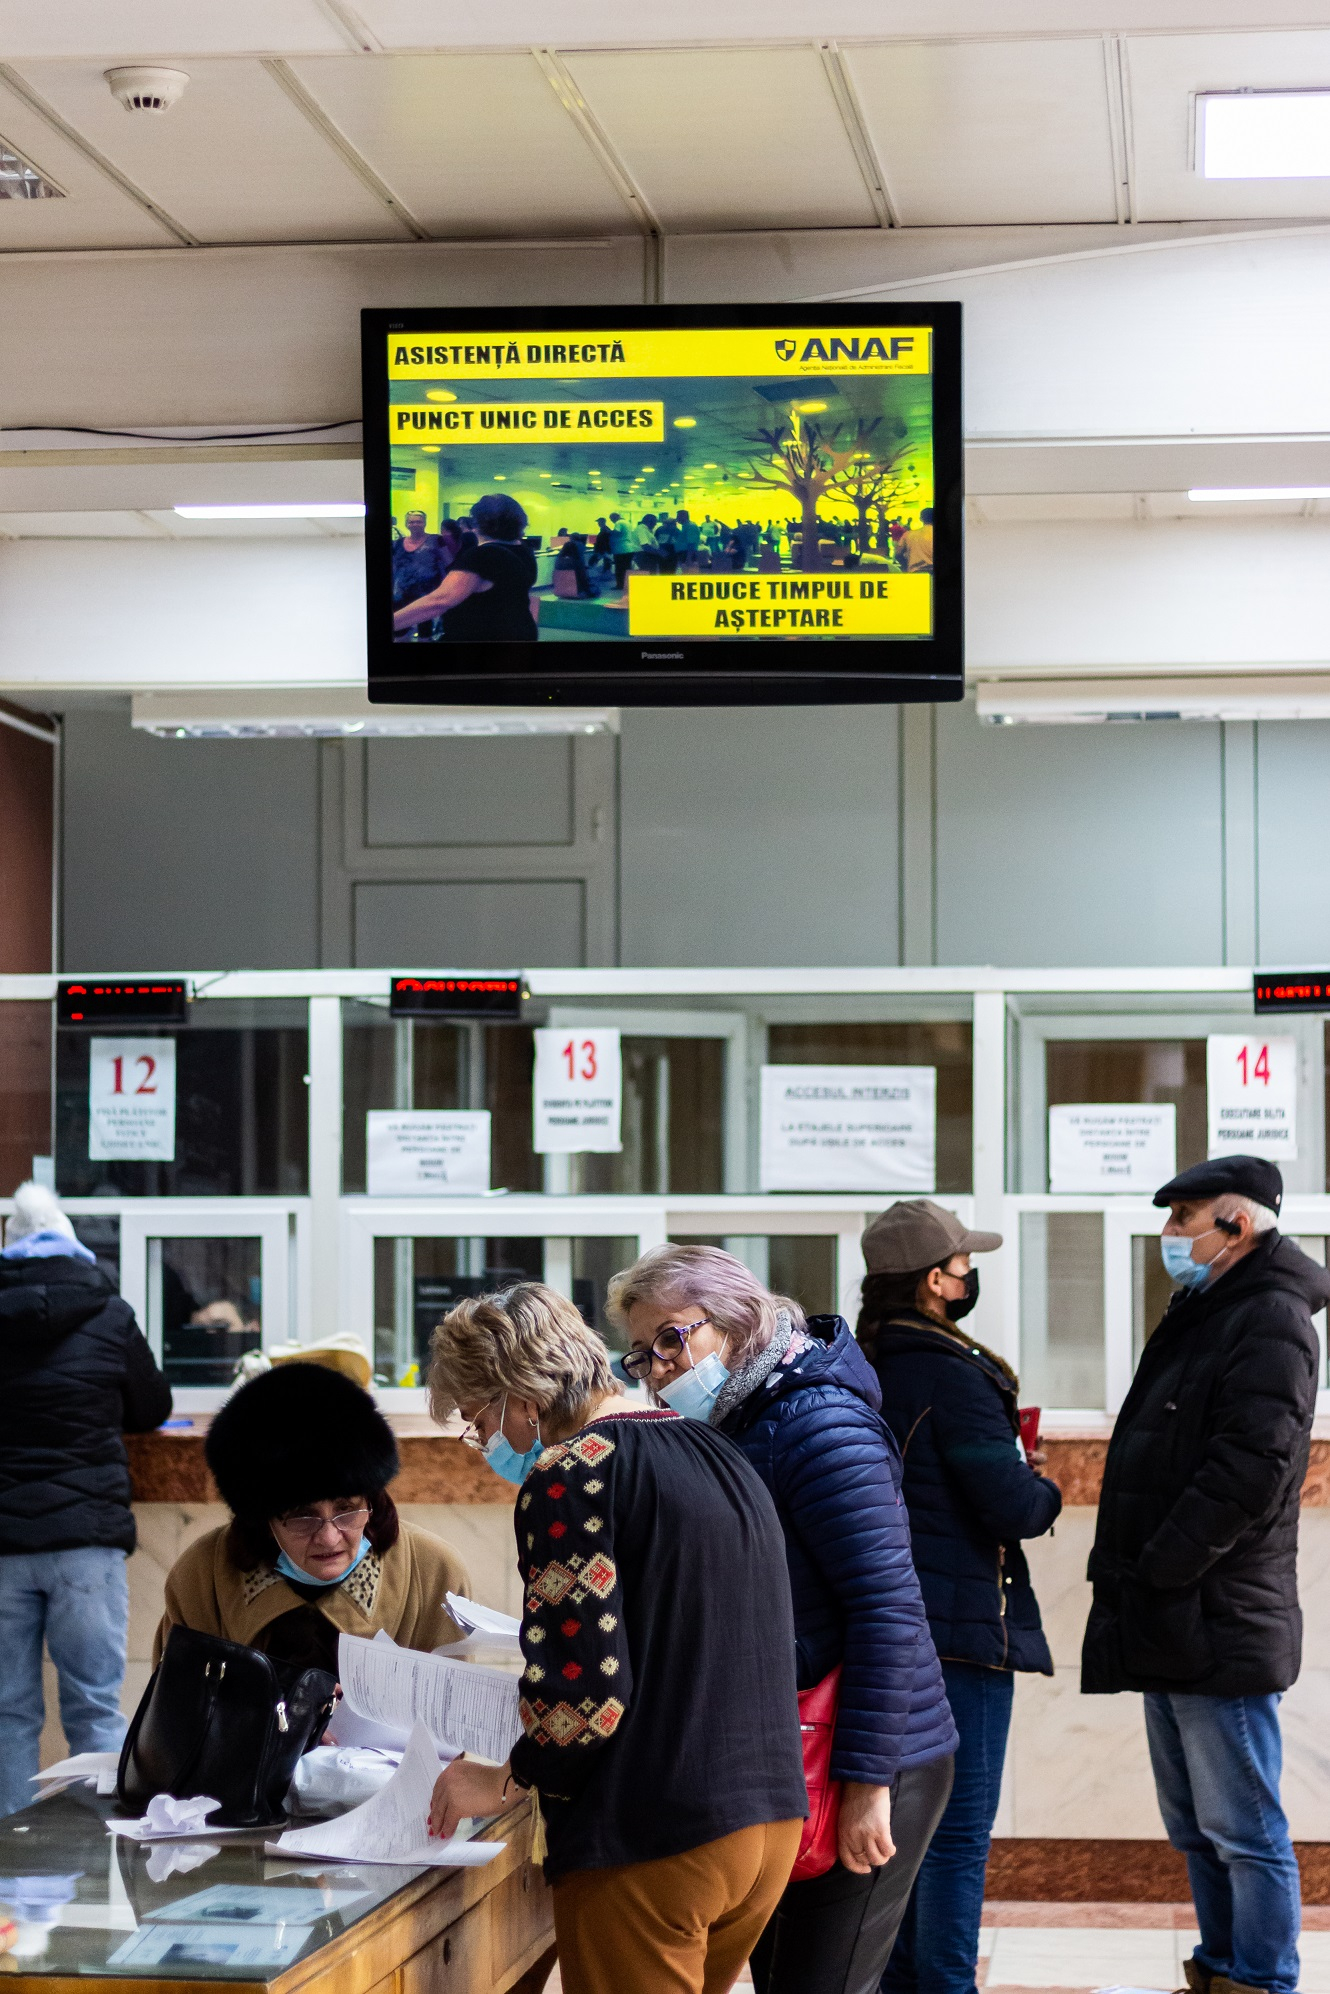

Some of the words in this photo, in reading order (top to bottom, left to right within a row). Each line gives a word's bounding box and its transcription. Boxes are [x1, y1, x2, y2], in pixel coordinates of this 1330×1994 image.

[394, 341, 521, 369] ASISTENȚĂ
[527, 340, 626, 363] DIRECTĂ
[800, 337, 914, 361] ANAF
[397, 411, 474, 430] PUNCT
[480, 411, 537, 429] UNIC
[544, 410, 572, 428] DE
[577, 409, 654, 428] ACCES
[671, 582, 761, 600] REDUCE
[767, 581, 854, 599] TIMPUL
[860, 581, 889, 599] DE
[714, 608, 844, 633] AȘTEPTARE
[641, 651, 684, 660] Panasonic
[562, 1040, 597, 1081] 13
[1236, 1044, 1271, 1086] 14
[111, 1055, 157, 1095] 12
